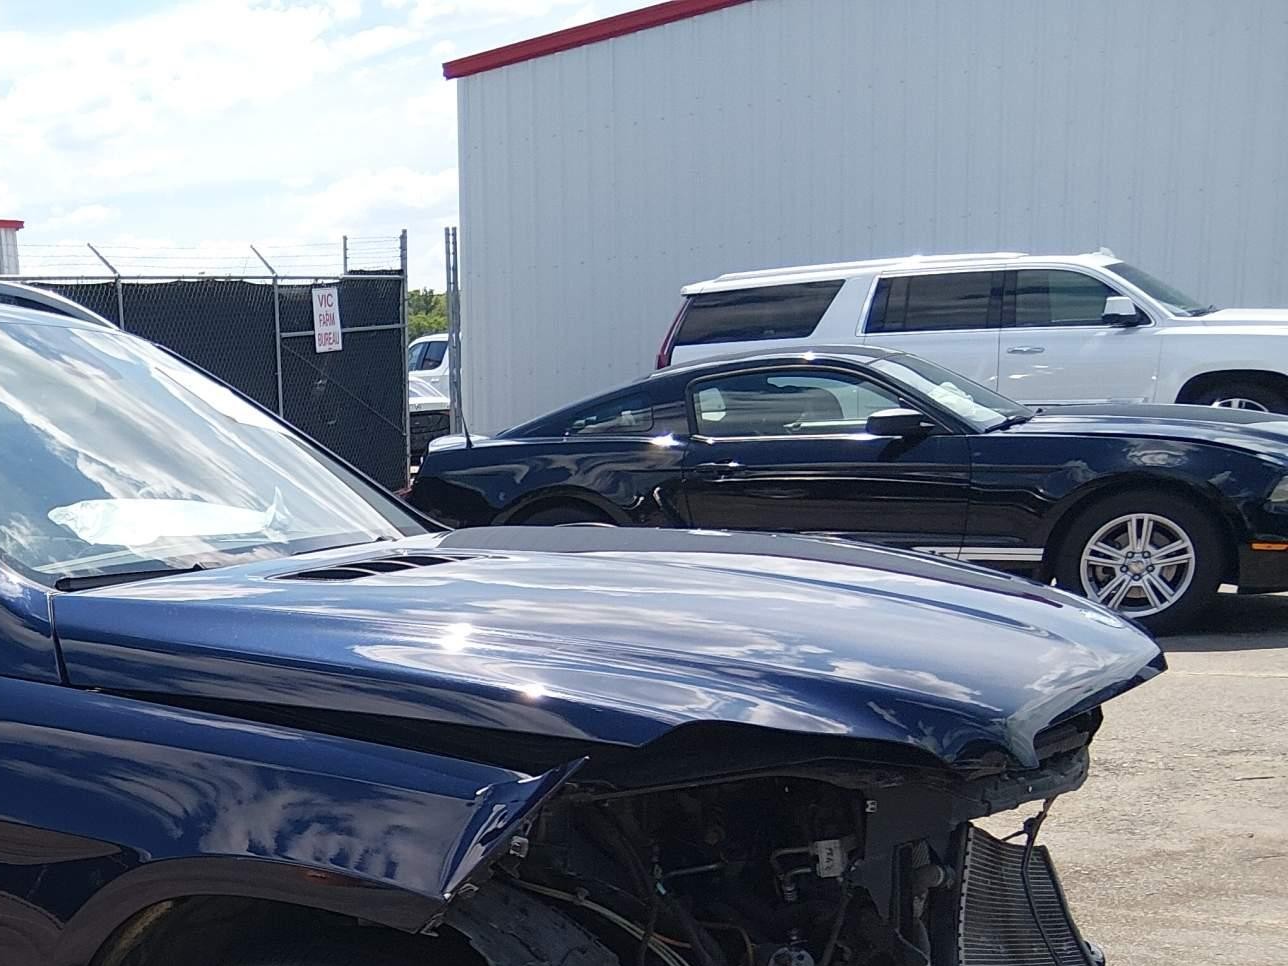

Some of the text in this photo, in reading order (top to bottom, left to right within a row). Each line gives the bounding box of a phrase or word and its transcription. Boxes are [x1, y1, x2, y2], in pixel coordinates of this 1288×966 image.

[317, 294, 334, 308] VIC
[319, 312, 336, 327] FARM
[318, 332, 340, 346] BUREAU
